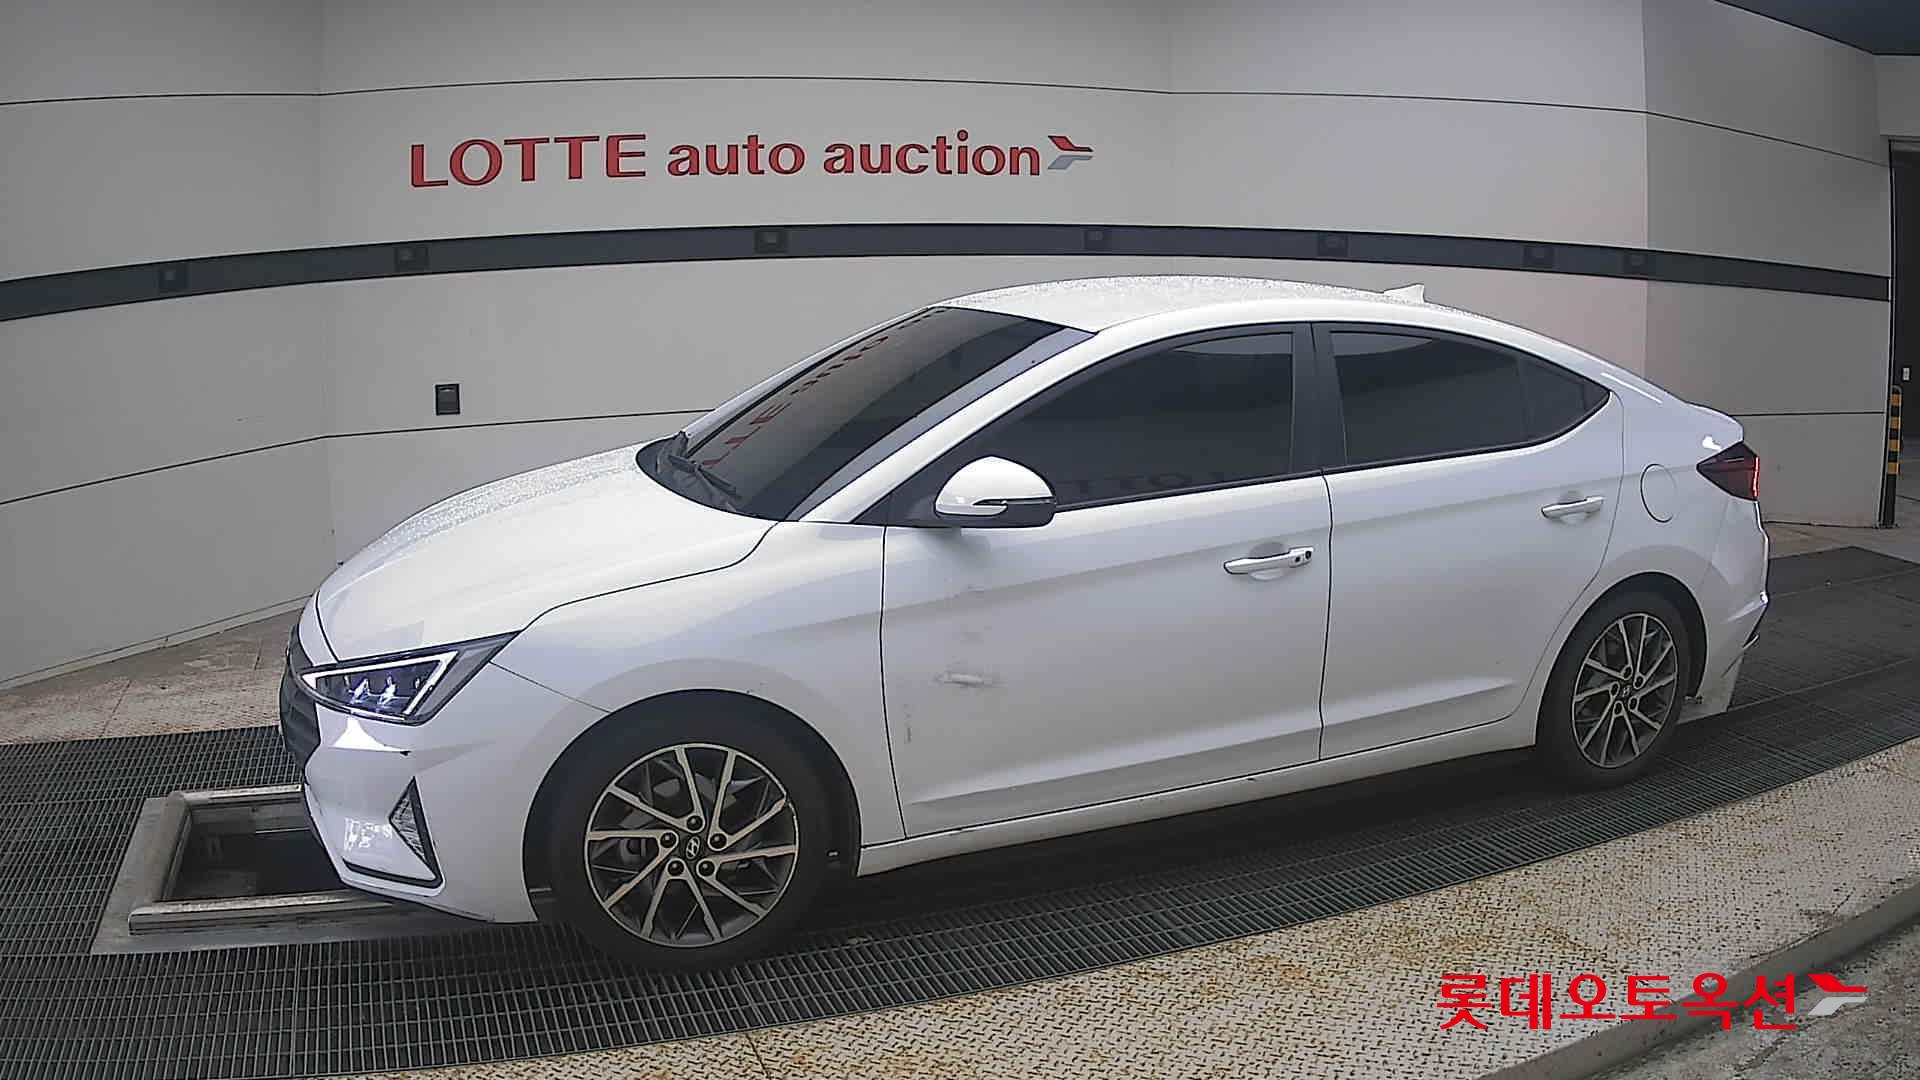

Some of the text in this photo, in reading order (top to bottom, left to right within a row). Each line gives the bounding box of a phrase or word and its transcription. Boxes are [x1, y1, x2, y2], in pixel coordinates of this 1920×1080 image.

[409, 129, 1041, 188] LOTTE auto auction
